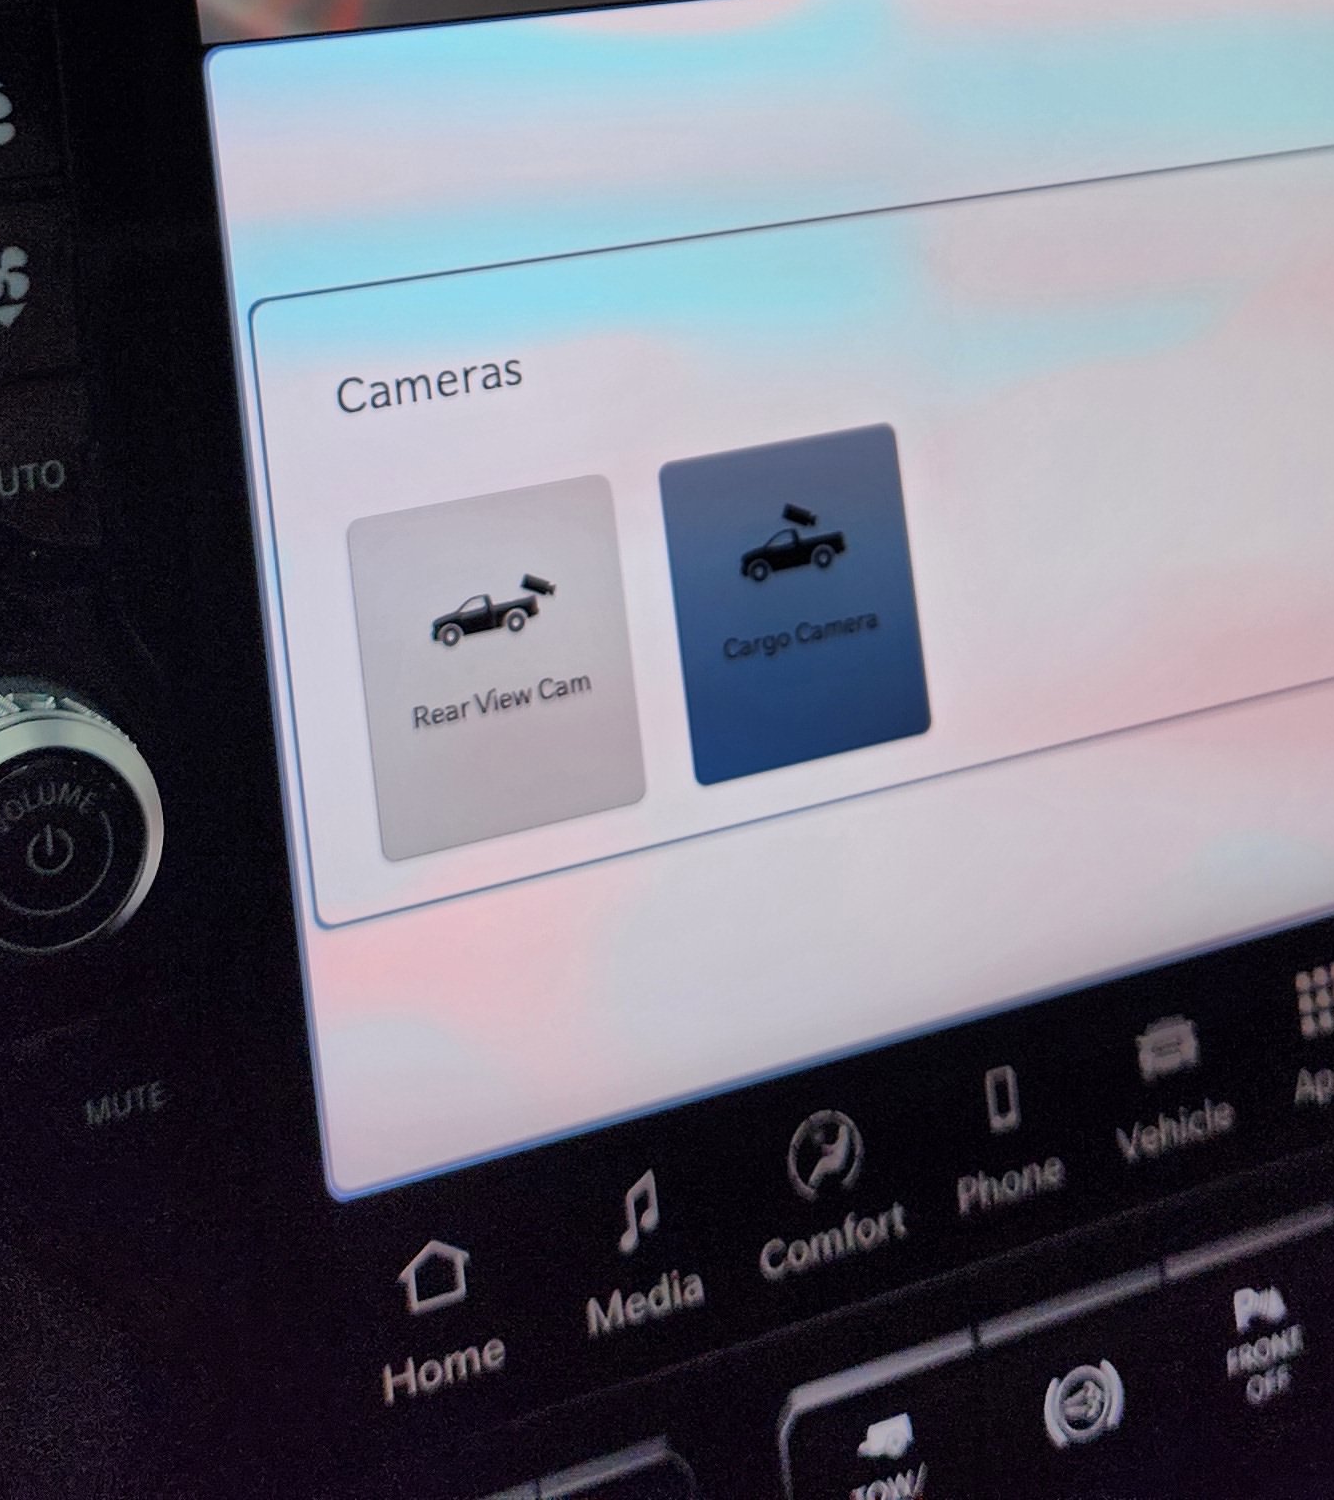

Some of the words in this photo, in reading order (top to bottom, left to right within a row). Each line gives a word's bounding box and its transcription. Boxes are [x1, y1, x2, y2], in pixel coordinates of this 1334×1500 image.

[336, 357, 523, 414] Cameras
[723, 631, 789, 661] Cargo
[795, 609, 879, 646] Camera
[413, 697, 469, 731] Rear
[472, 684, 531, 716] View
[537, 672, 592, 701] Cam
[85, 1082, 169, 1126] MUTE
[1116, 1099, 1236, 1162] Vehicle
[956, 1156, 1066, 1214] Phone
[759, 1202, 907, 1280] Comfort
[586, 1270, 705, 1337] Media
[381, 1337, 506, 1403] Home
[1227, 1323, 1304, 1380] FRONT
[1245, 1363, 1292, 1403] OFF
